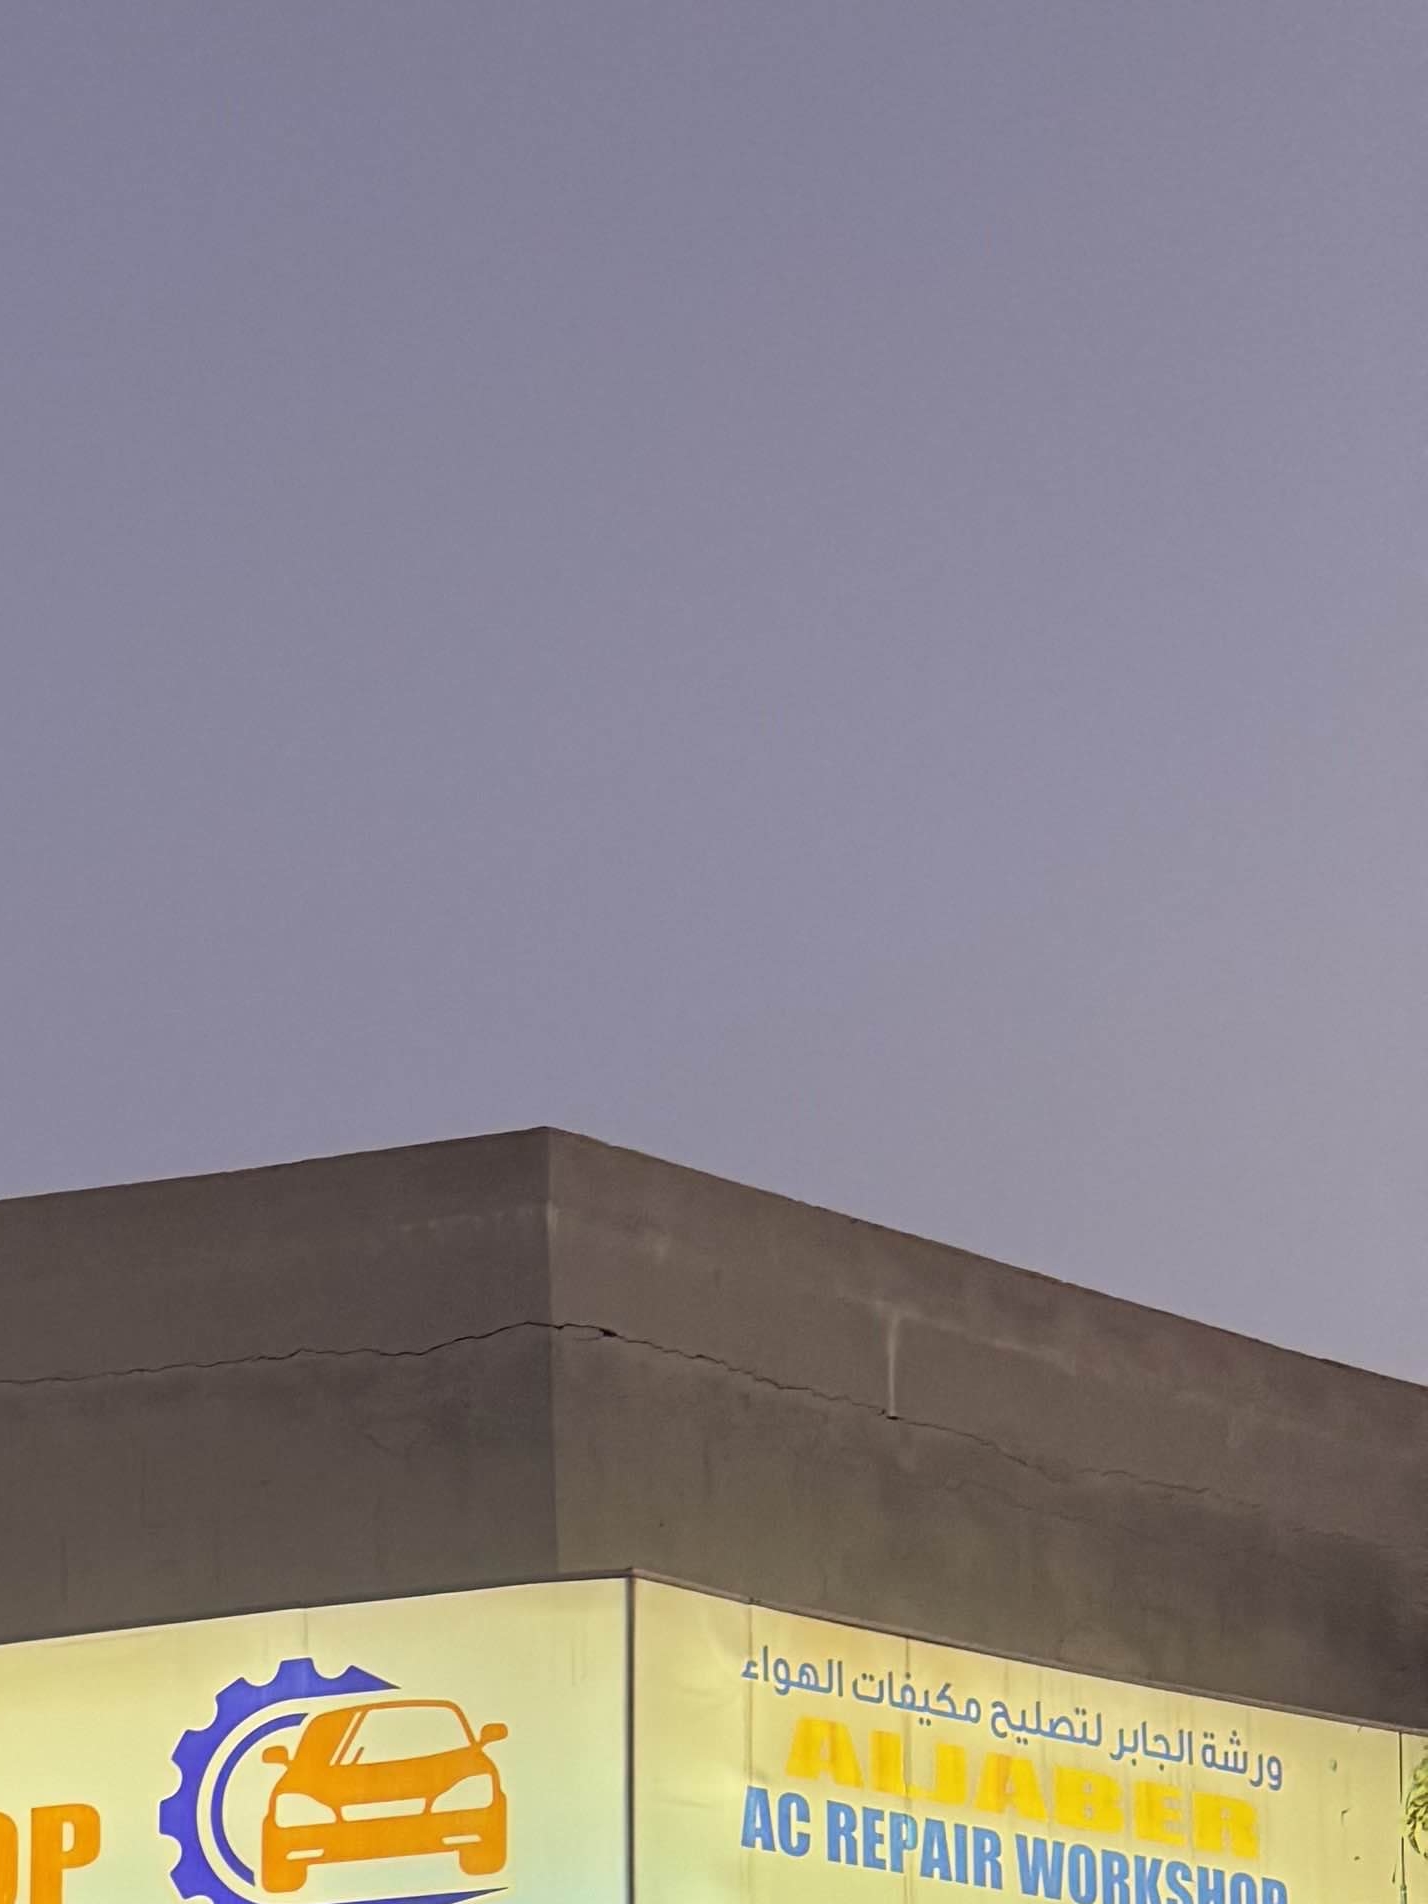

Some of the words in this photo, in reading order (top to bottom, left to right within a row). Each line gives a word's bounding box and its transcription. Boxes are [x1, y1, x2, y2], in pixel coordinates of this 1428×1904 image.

[740, 1645, 844, 1697] الهواء
[851, 1672, 982, 1727] مكيفات
[990, 1699, 1102, 1747] لتصليح
[1110, 1720, 1194, 1771] الجابر
[1201, 1730, 1284, 1792] ورشة
[785, 1715, 1260, 1859] ALJABER
[741, 1785, 811, 1858] AC
[826, 1800, 1003, 1891] REPAIR
